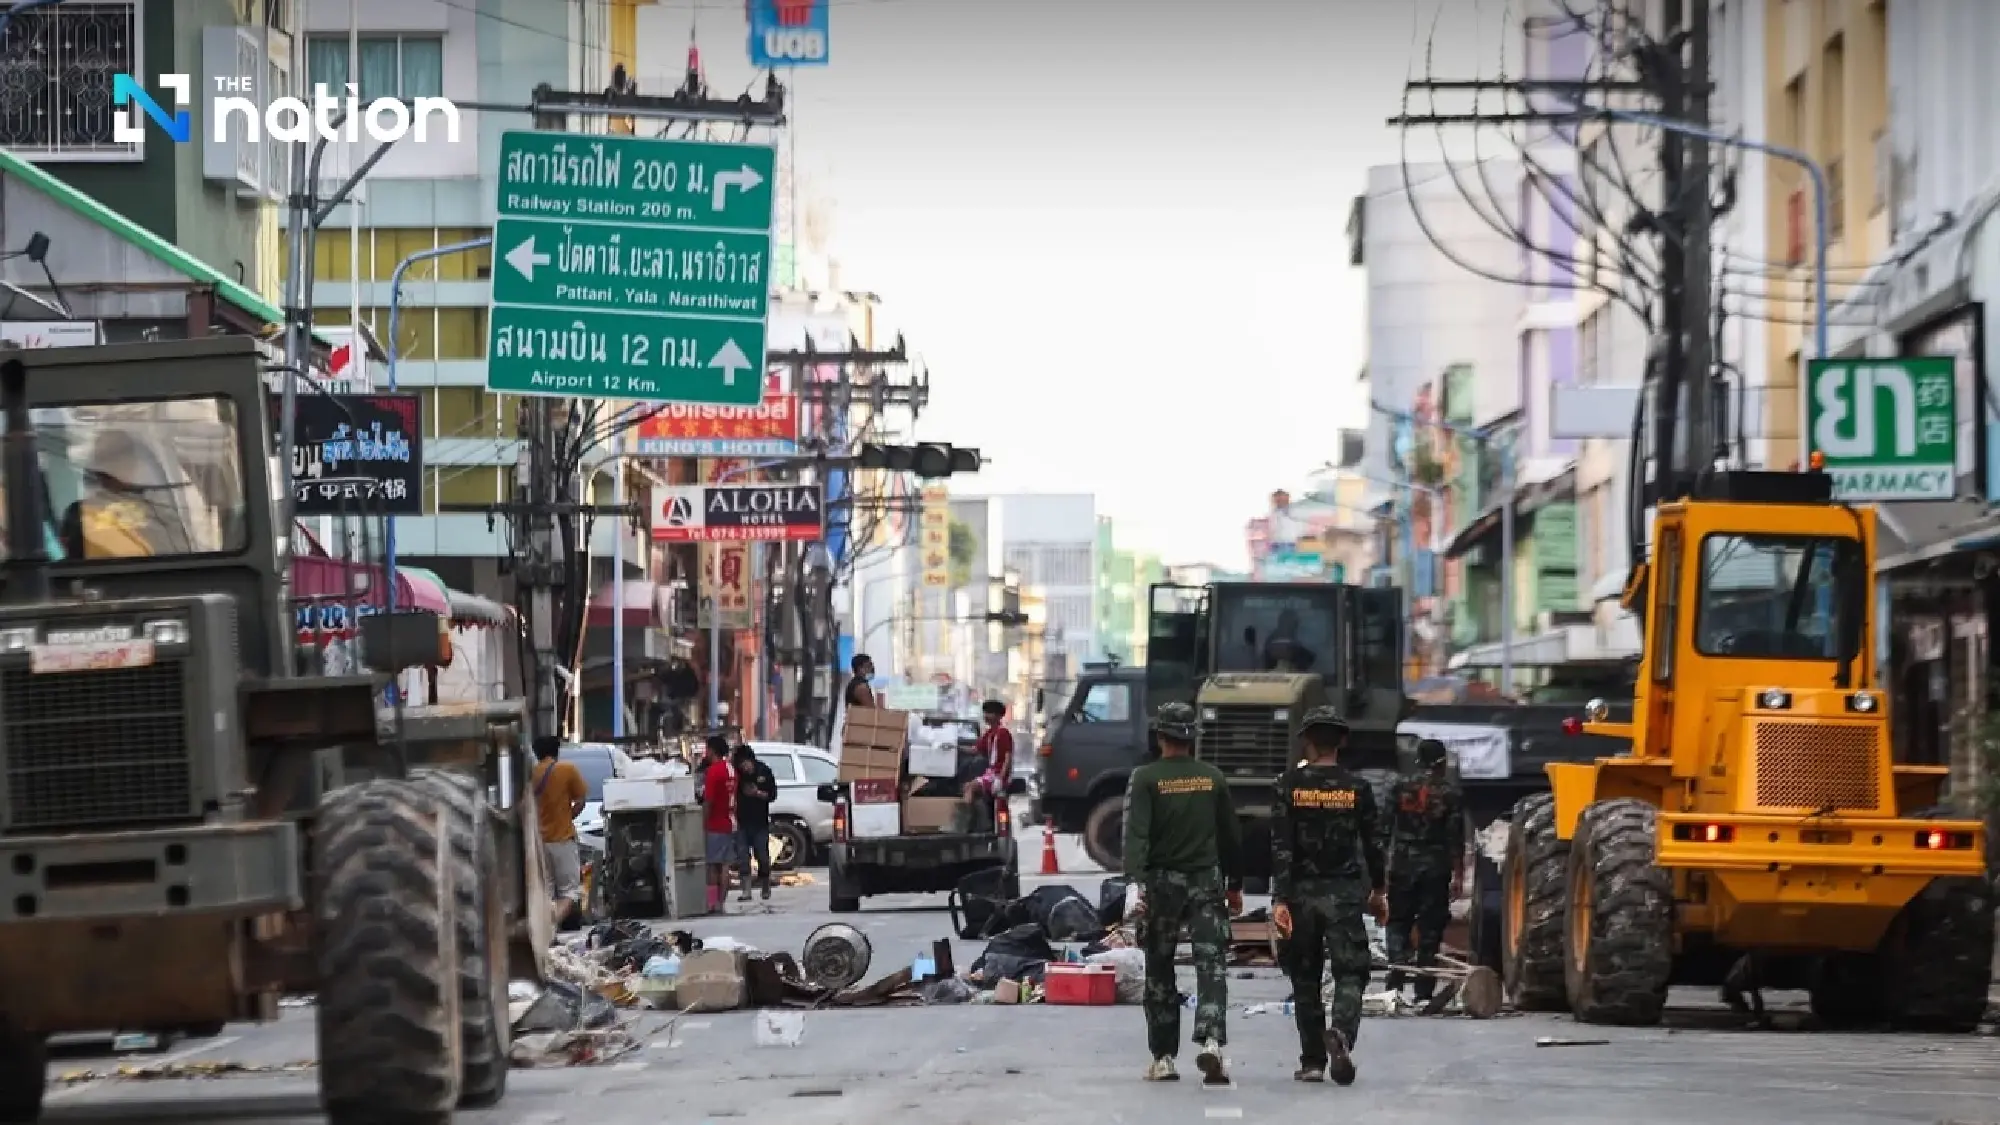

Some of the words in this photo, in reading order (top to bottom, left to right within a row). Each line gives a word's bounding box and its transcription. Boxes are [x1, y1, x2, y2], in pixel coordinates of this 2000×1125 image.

[765, 28, 825, 58] UOB
[507, 142, 621, 189] สถานีรถไฟ
[632, 159, 677, 191] 200
[687, 162, 709, 194] ม.
[507, 194, 571, 214] Railway
[576, 199, 635, 216] Station
[641, 202, 671, 217] 200
[676, 206, 696, 220] m.
[669, 291, 757, 310] Narathiwat
[497, 320, 607, 363] สนามบิน
[621, 334, 649, 366] 12
[662, 336, 702, 369] กม.
[531, 370, 592, 388] Airport
[603, 375, 621, 390] 12
[627, 376, 660, 392] Km.
[1814, 366, 1918, 458] ยา
[1917, 375, 1951, 445] 药店
[721, 440, 792, 454] HOTEL
[1832, 471, 1948, 493] HARMACY
[708, 490, 818, 513] ALOHA
[740, 513, 786, 526] HOTEL
